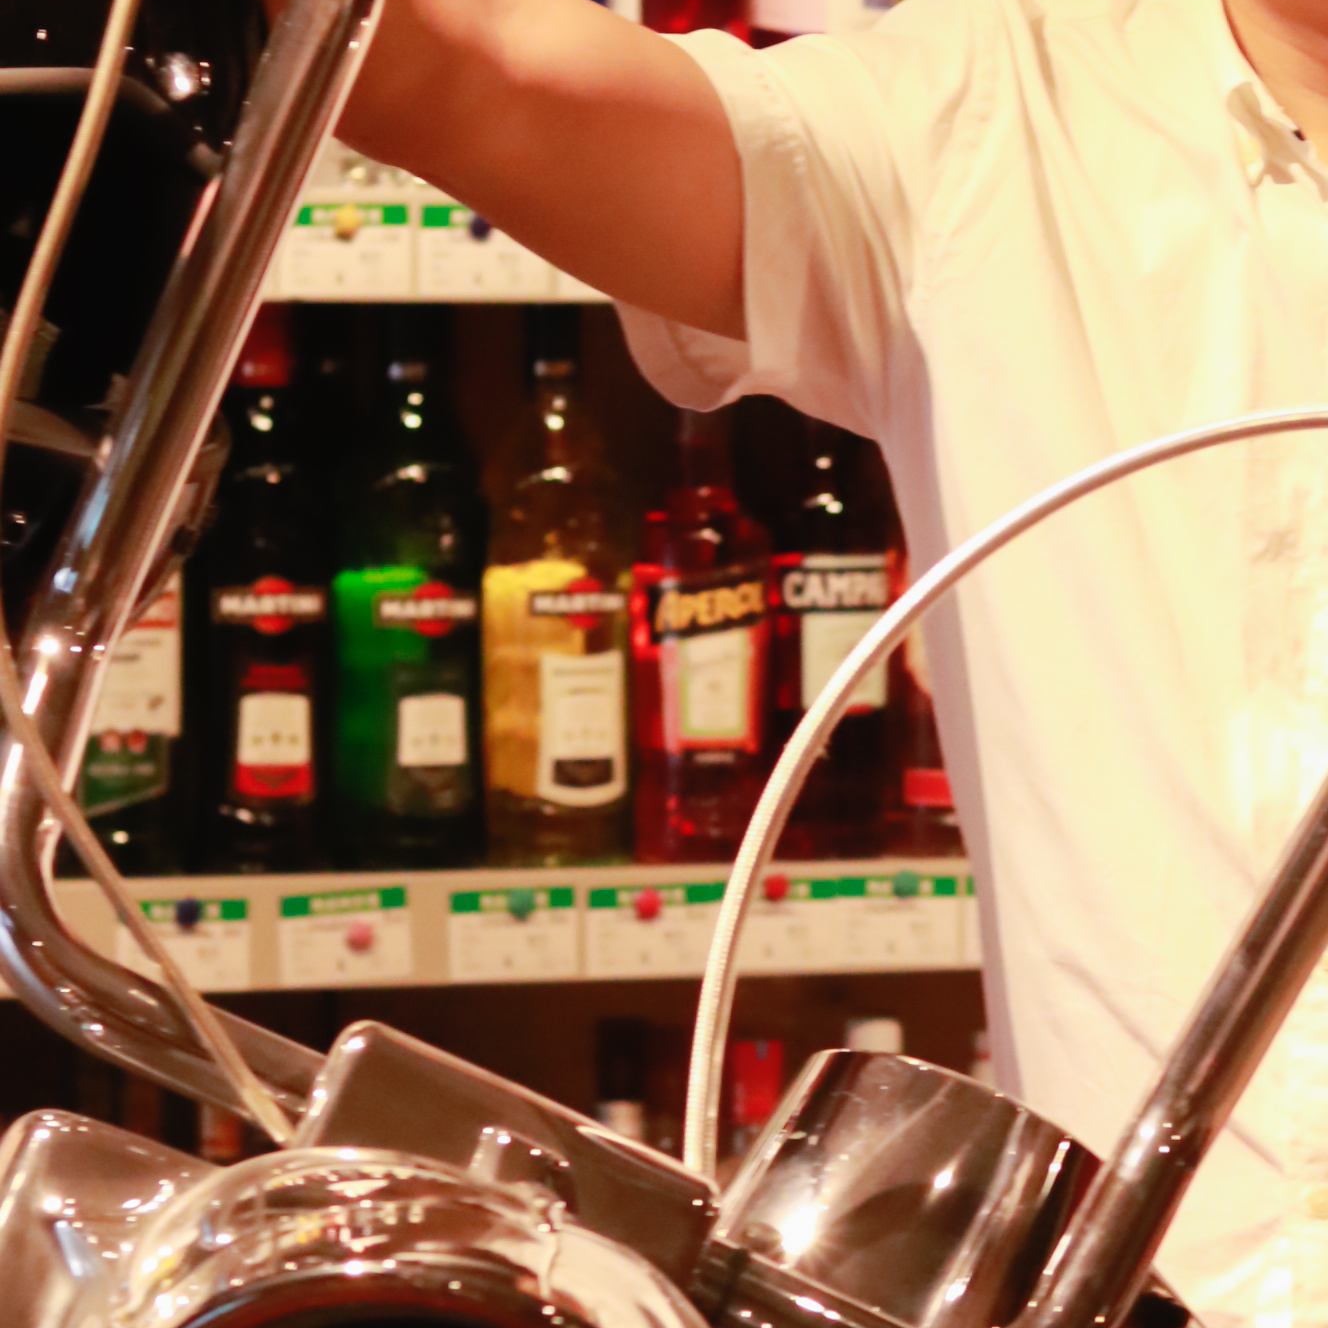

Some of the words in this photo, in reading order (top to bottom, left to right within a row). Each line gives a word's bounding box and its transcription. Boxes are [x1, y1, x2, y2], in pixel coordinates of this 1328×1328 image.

[218, 593, 323, 616] MARTINI
[378, 597, 477, 620] MARTINI
[530, 591, 626, 614] MARTINI
